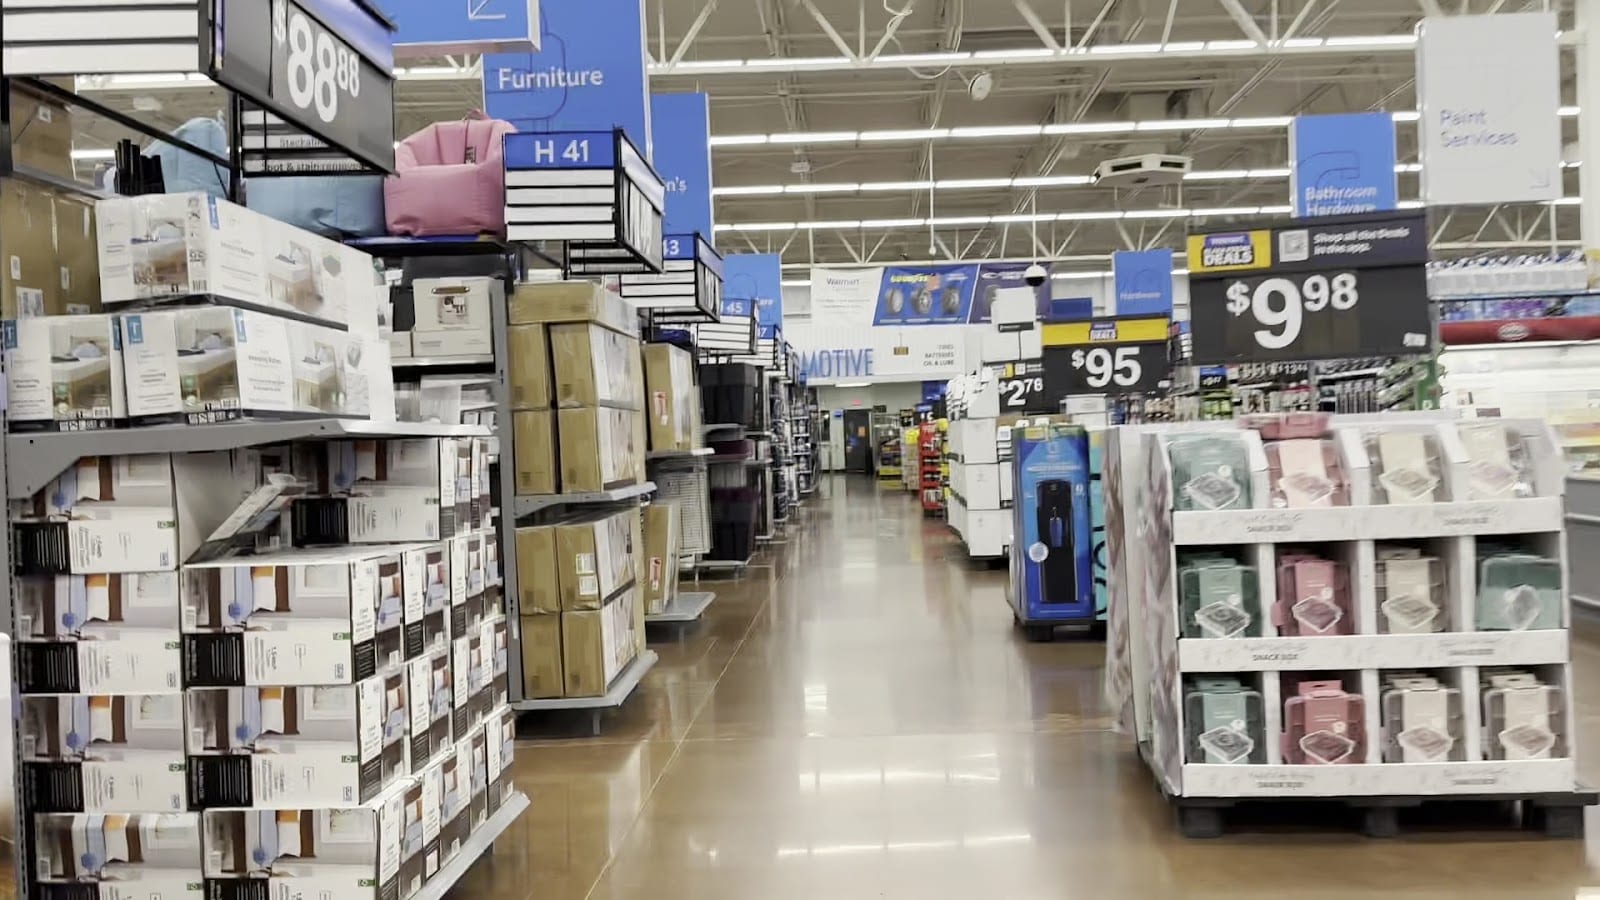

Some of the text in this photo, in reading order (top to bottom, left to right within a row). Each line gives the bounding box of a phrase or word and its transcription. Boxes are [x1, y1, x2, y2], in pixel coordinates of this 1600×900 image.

[499, 66, 604, 89] Furniture
[1440, 109, 1487, 126] Paint
[1440, 131, 1519, 148] Services
[534, 140, 589, 163] H 41
[664, 176, 688, 193] n's
[1306, 186, 1377, 201] Bathroom
[1306, 202, 1377, 216] Hardware
[726, 302, 744, 313] 45
[1072, 347, 1142, 388] $95
